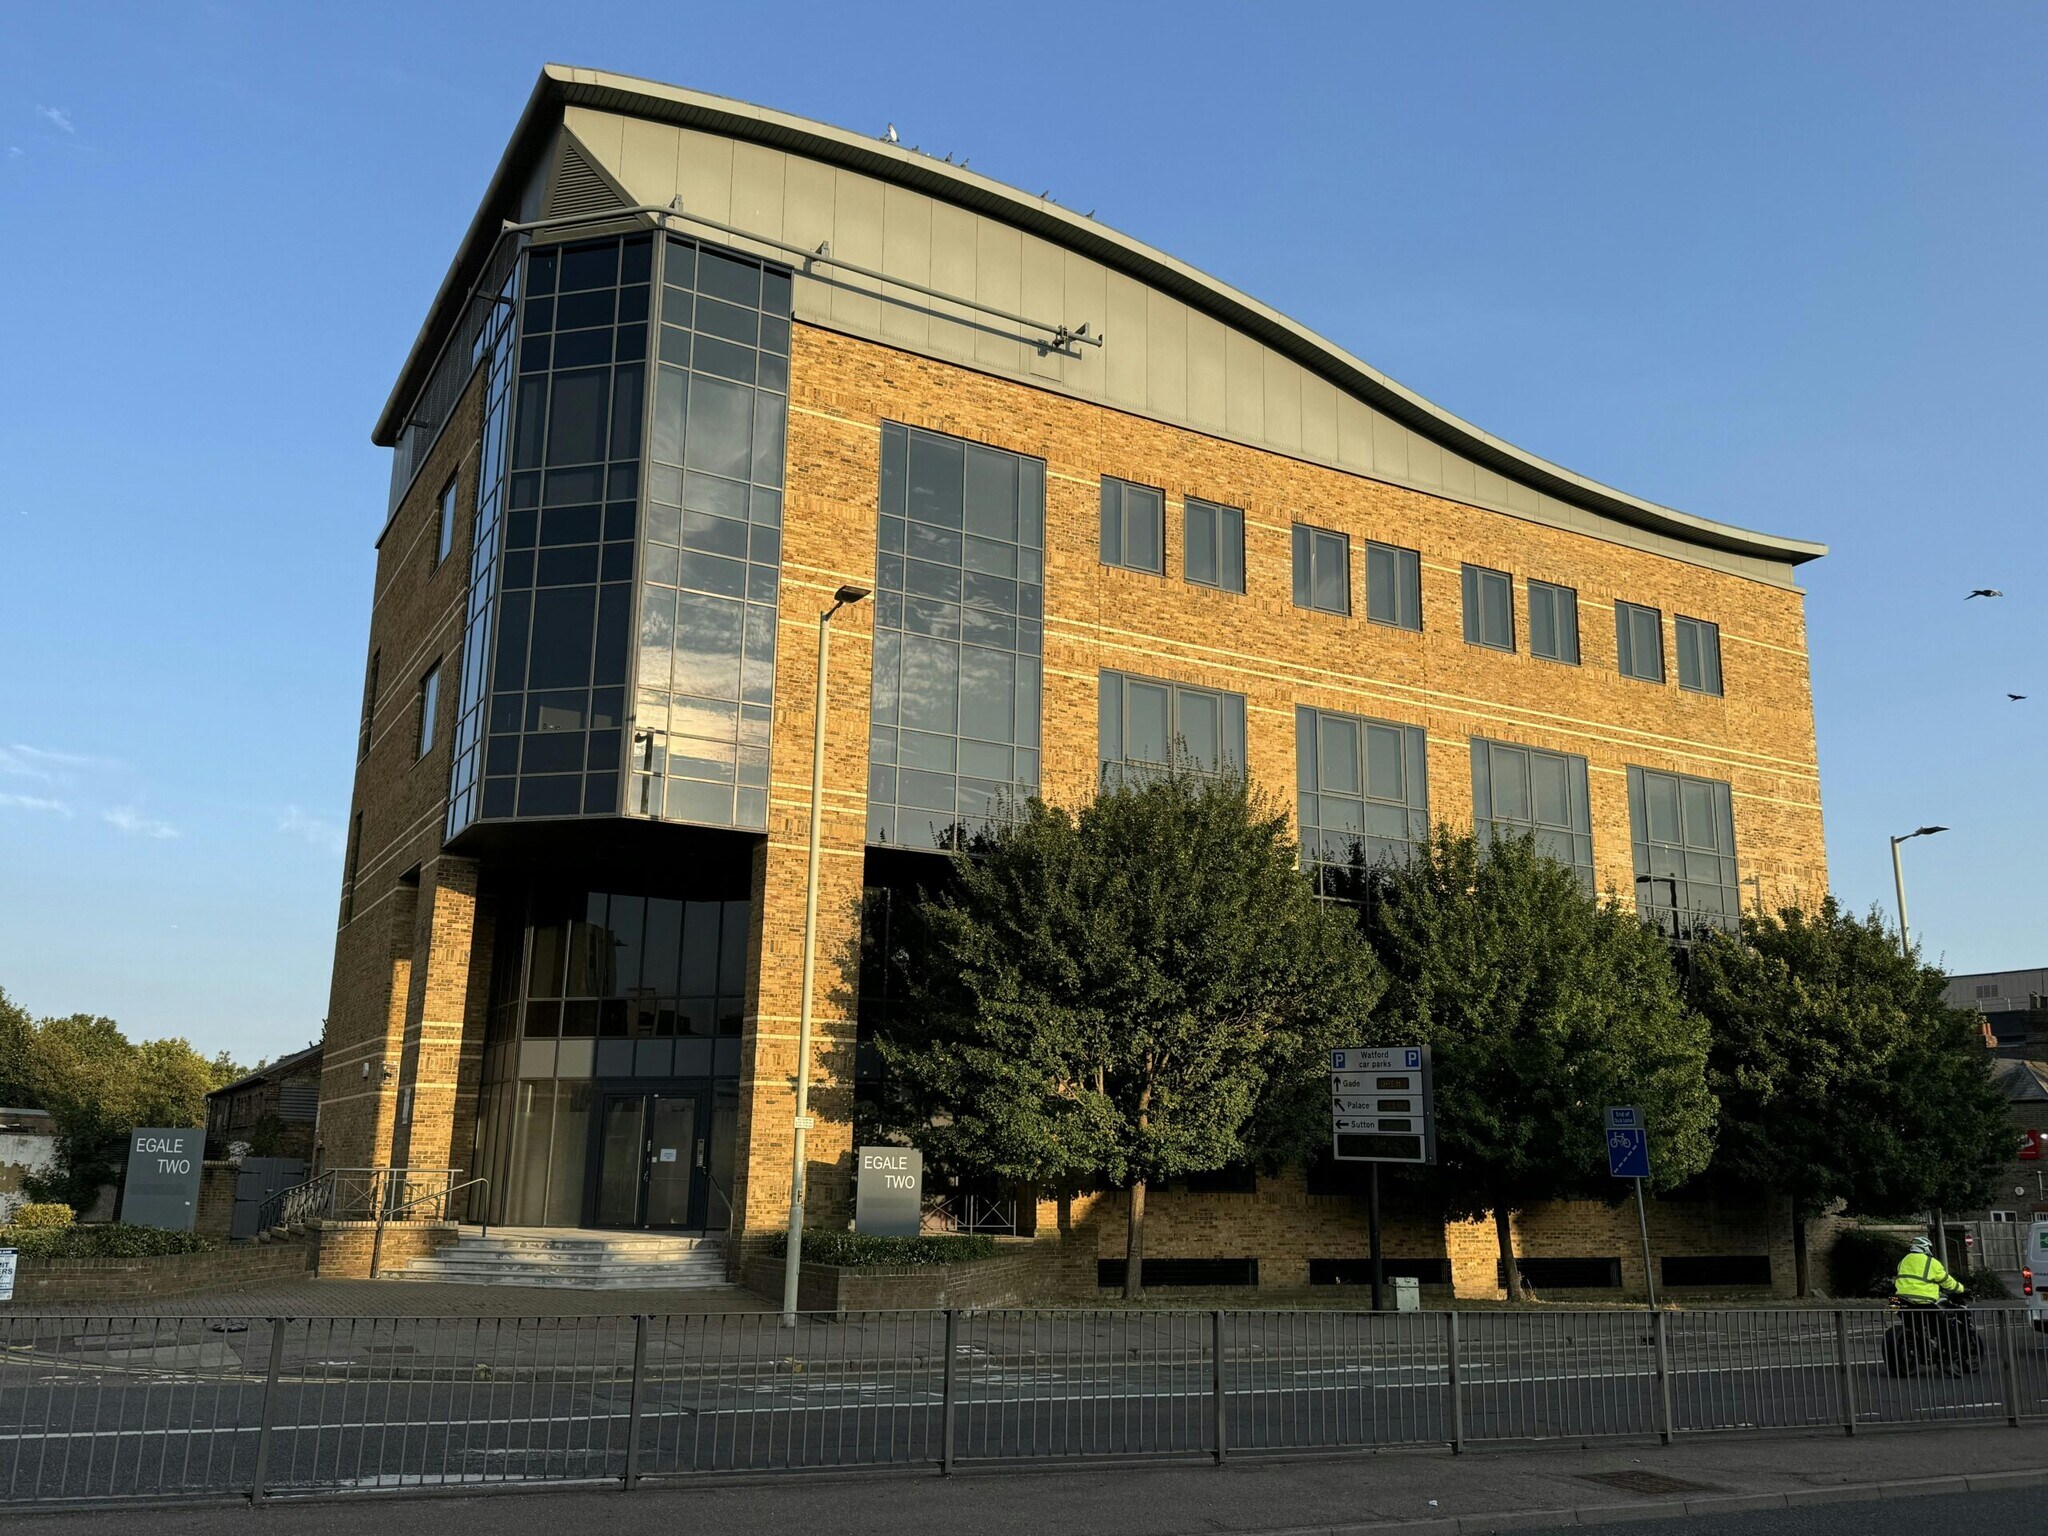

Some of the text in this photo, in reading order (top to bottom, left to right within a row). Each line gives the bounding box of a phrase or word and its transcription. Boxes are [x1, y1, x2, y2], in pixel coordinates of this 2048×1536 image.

[1360, 1051, 1389, 1059] Watford
[1372, 1061, 1392, 1069] parks
[1342, 1080, 1361, 1088] Gade
[1347, 1101, 1370, 1109] Palace
[1351, 1120, 1375, 1129] Sutton
[136, 1137, 184, 1153] EGALE
[157, 1158, 190, 1174] TWO
[864, 1155, 908, 1170] EGALE
[884, 1175, 915, 1189] TWO
